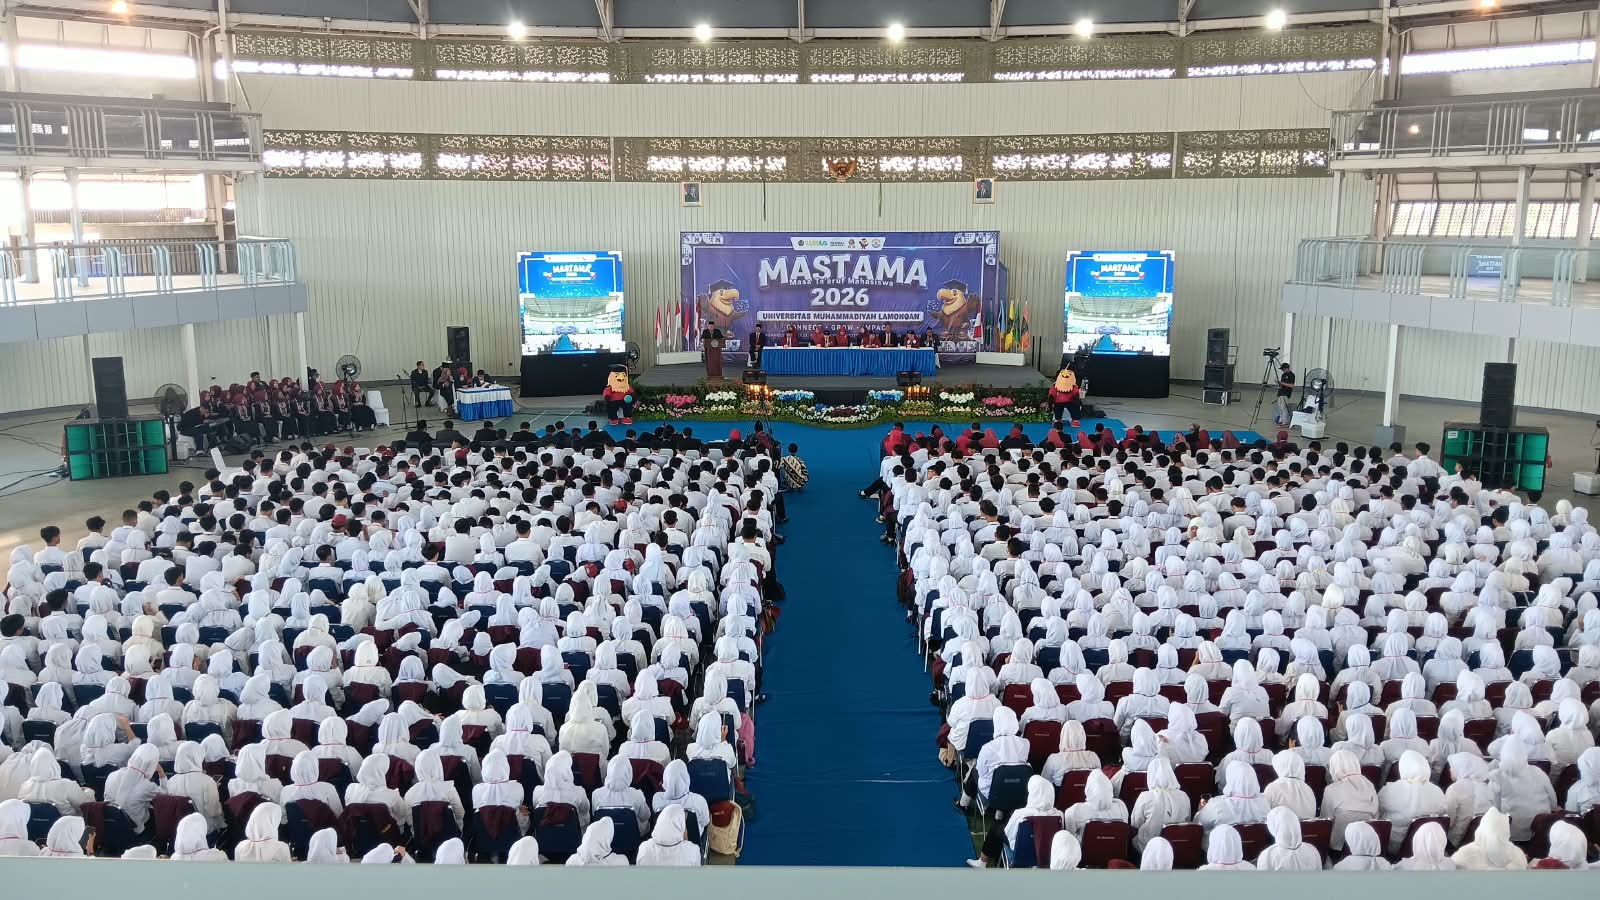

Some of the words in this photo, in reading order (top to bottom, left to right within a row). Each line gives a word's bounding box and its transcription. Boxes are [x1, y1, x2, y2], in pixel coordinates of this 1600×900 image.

[759, 254, 928, 288] MASTAMA
[847, 277, 894, 287] Mahasiswa
[810, 287, 870, 306] 2026
[762, 312, 812, 320] UNIVERSITAS
[813, 312, 877, 320] MUHAMMADIYAH
